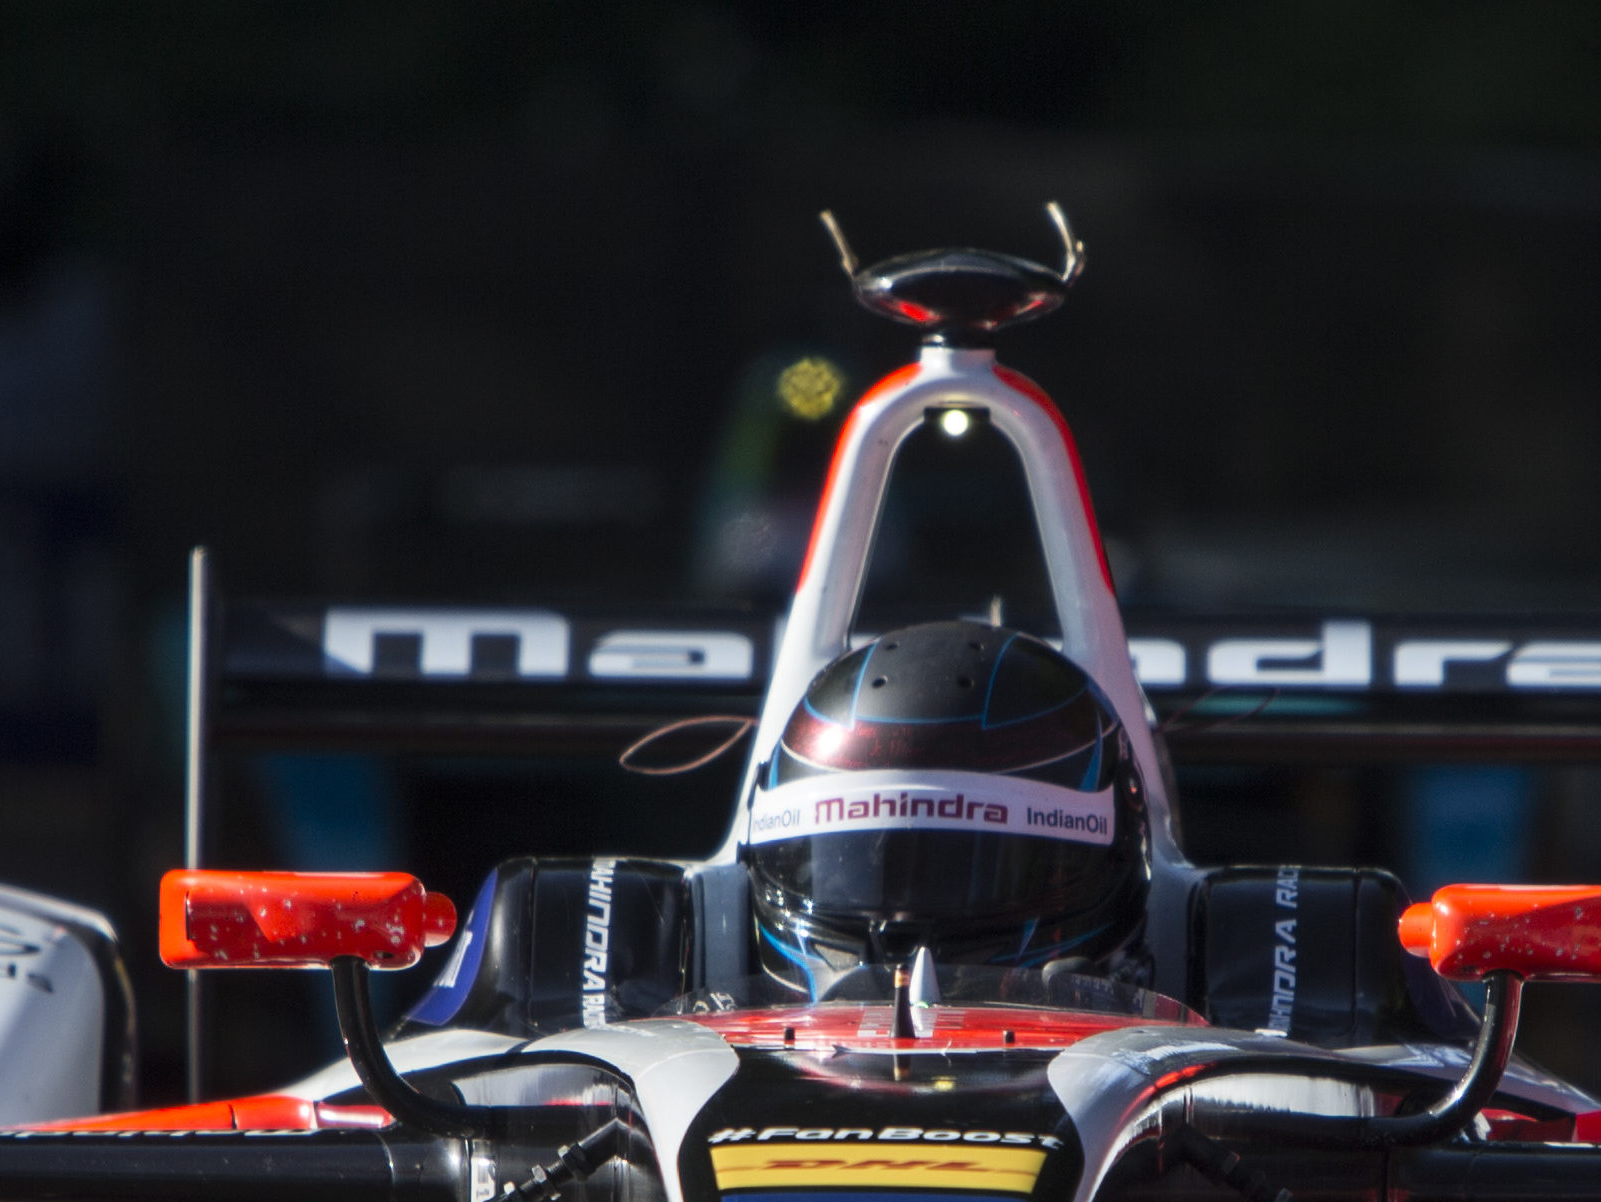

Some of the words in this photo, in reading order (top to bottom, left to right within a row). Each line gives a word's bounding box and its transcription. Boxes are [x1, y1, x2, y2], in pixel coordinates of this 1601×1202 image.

[814, 792, 1009, 826] Mahindra
[1026, 806, 1108, 836] IndianOil
[708, 1127, 1064, 1149] #FanBoost
[759, 1160, 990, 1172] DHL
